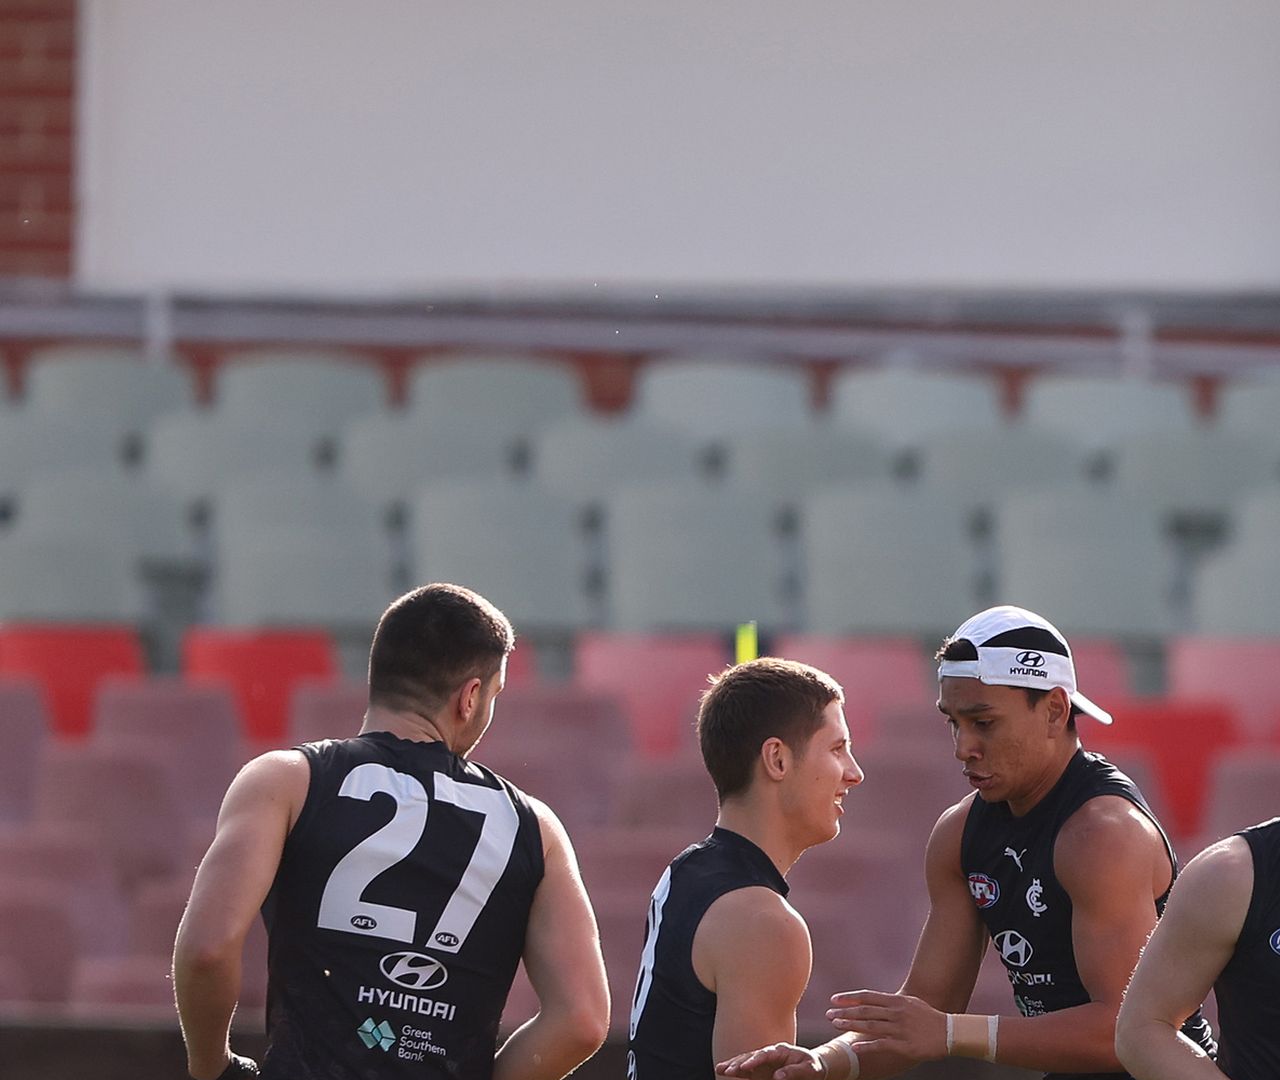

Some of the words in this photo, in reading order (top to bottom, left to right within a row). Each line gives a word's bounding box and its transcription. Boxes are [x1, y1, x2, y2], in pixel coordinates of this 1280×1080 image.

[1009, 667, 1048, 679] HYUNDAI
[316, 762, 520, 954] 27
[352, 917, 377, 929] AFL
[436, 934, 459, 946] AFL
[358, 986, 456, 1021] HYUNDAI
[401, 1025, 432, 1041] Great
[400, 1036, 446, 1056] Southern
[398, 1047, 424, 1061] Bank
